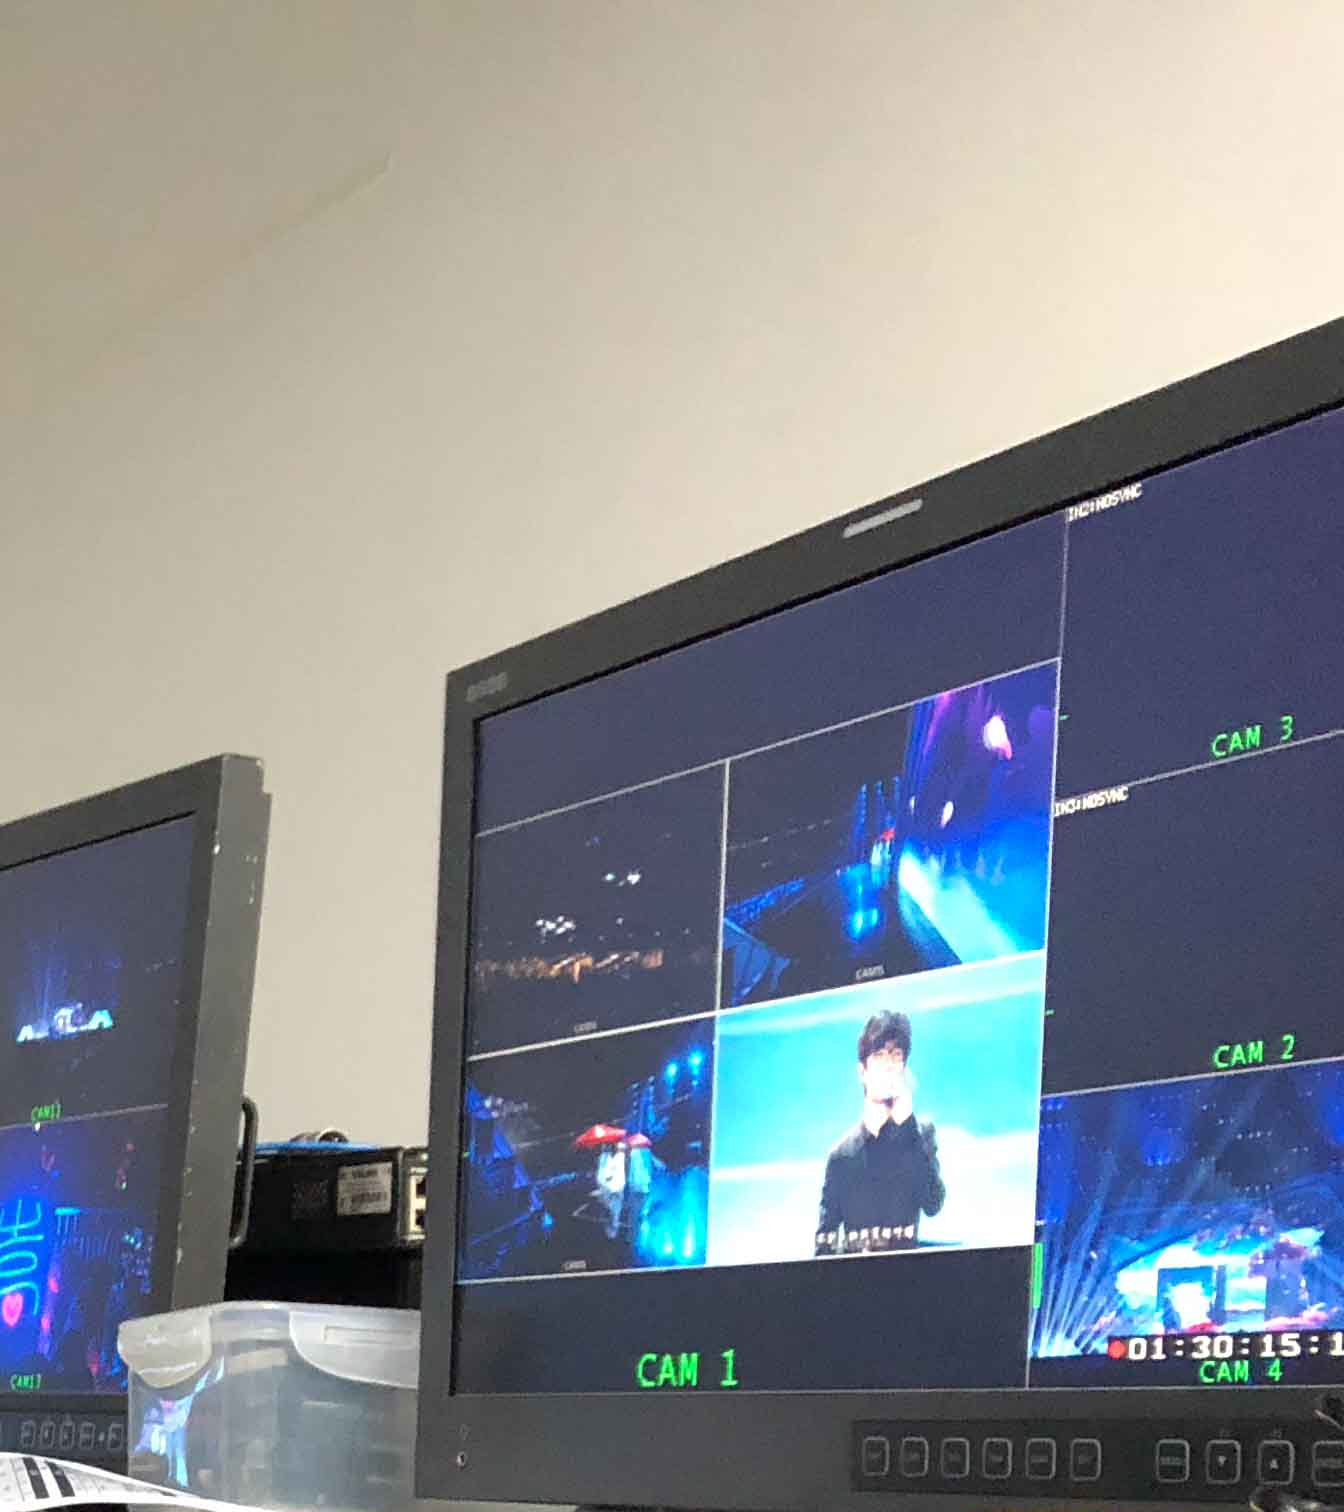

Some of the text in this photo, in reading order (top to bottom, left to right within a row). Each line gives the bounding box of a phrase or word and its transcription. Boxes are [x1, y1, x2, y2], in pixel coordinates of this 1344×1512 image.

[1211, 715, 1294, 757] CAM 3
[1214, 1034, 1296, 1068] CAM 2
[636, 1348, 739, 1388] CAM 1
[1199, 1357, 1283, 1384] CAM 4
